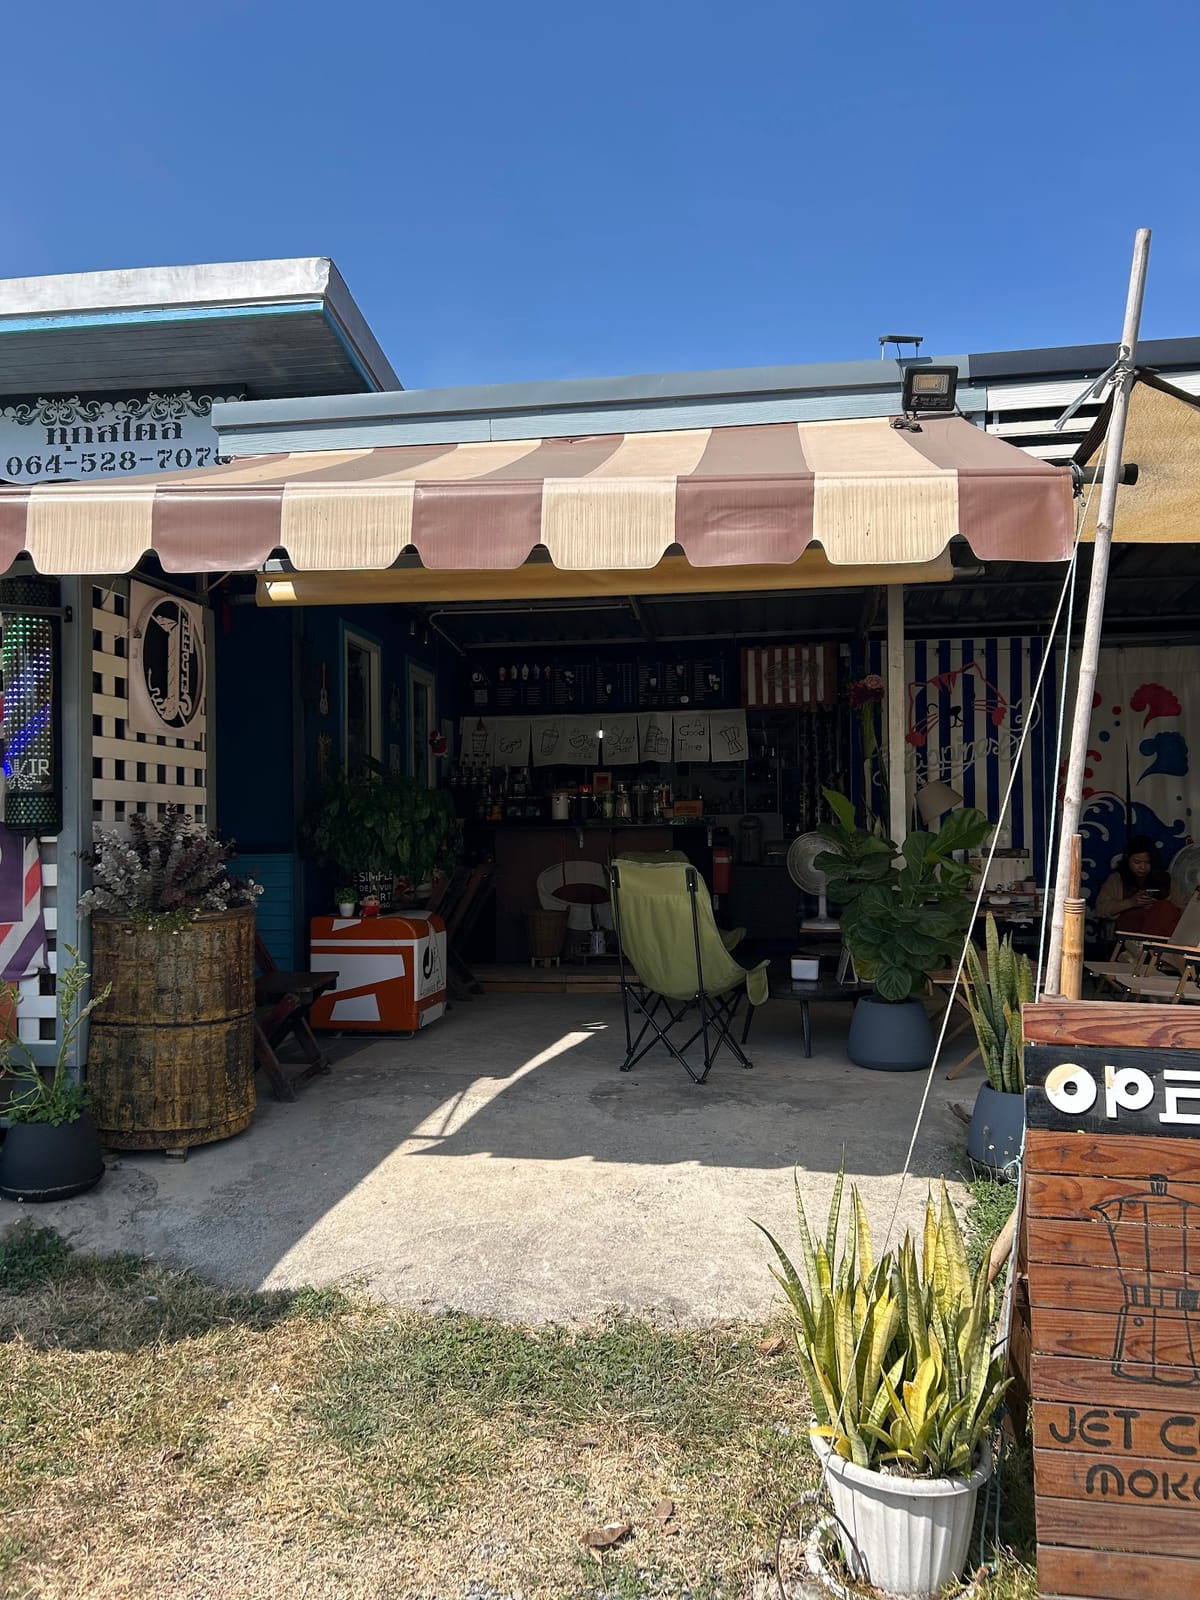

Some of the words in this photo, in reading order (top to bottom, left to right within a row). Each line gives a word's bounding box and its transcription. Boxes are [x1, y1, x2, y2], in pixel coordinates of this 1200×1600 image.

[679, 724, 705, 737] Good
[677, 739, 703, 752] Time
[1049, 1406, 1141, 1450] JET
[1160, 1416, 1200, 1456] C
[1085, 1463, 1200, 1501] MOK
